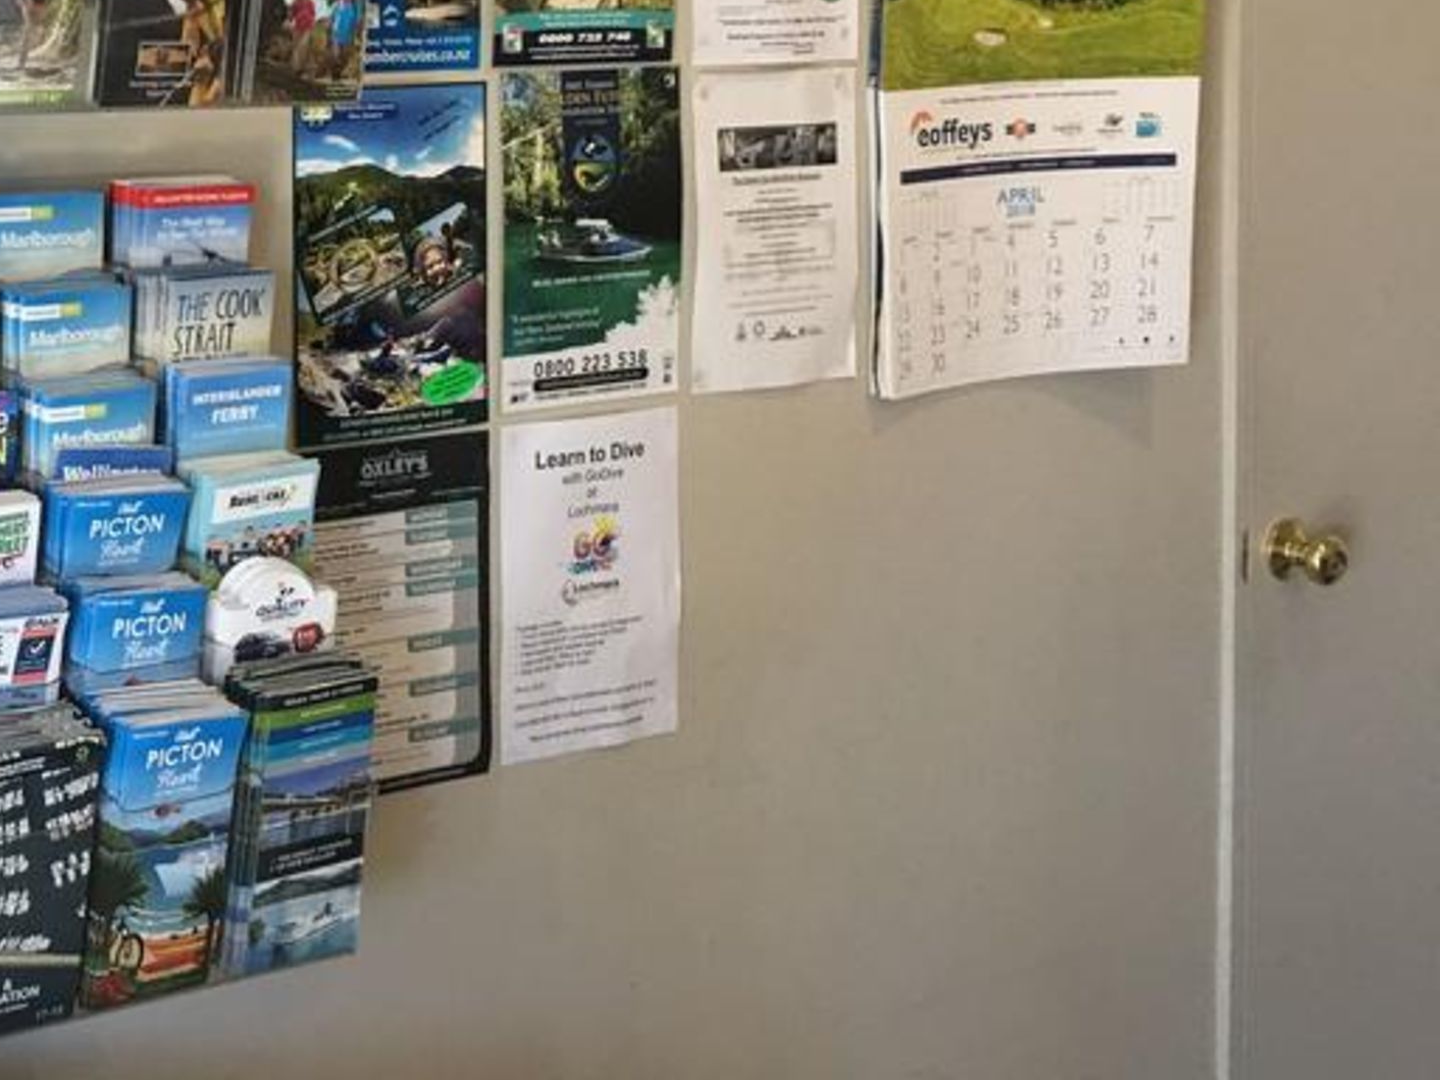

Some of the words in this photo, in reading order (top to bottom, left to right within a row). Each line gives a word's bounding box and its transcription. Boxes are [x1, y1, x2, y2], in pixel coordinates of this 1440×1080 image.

[997, 187, 1044, 204] APRIL
[0, 228, 92, 249] Marlborough
[178, 293, 208, 322] THE
[216, 288, 265, 318] COOK
[29, 324, 120, 345] Marlborough
[173, 323, 235, 354] STRAIT
[534, 357, 575, 378] 0800
[582, 353, 611, 373] 223
[617, 349, 648, 368] 538
[212, 404, 259, 424] FERRY
[535, 446, 585, 470] Learn
[590, 444, 606, 463] to
[610, 440, 645, 461] Dive
[562, 470, 583, 485] with
[90, 514, 164, 538] PICTON
[112, 613, 186, 639] PICTON
[147, 738, 222, 769] PICTON
[3, 978, 13, 993] &
